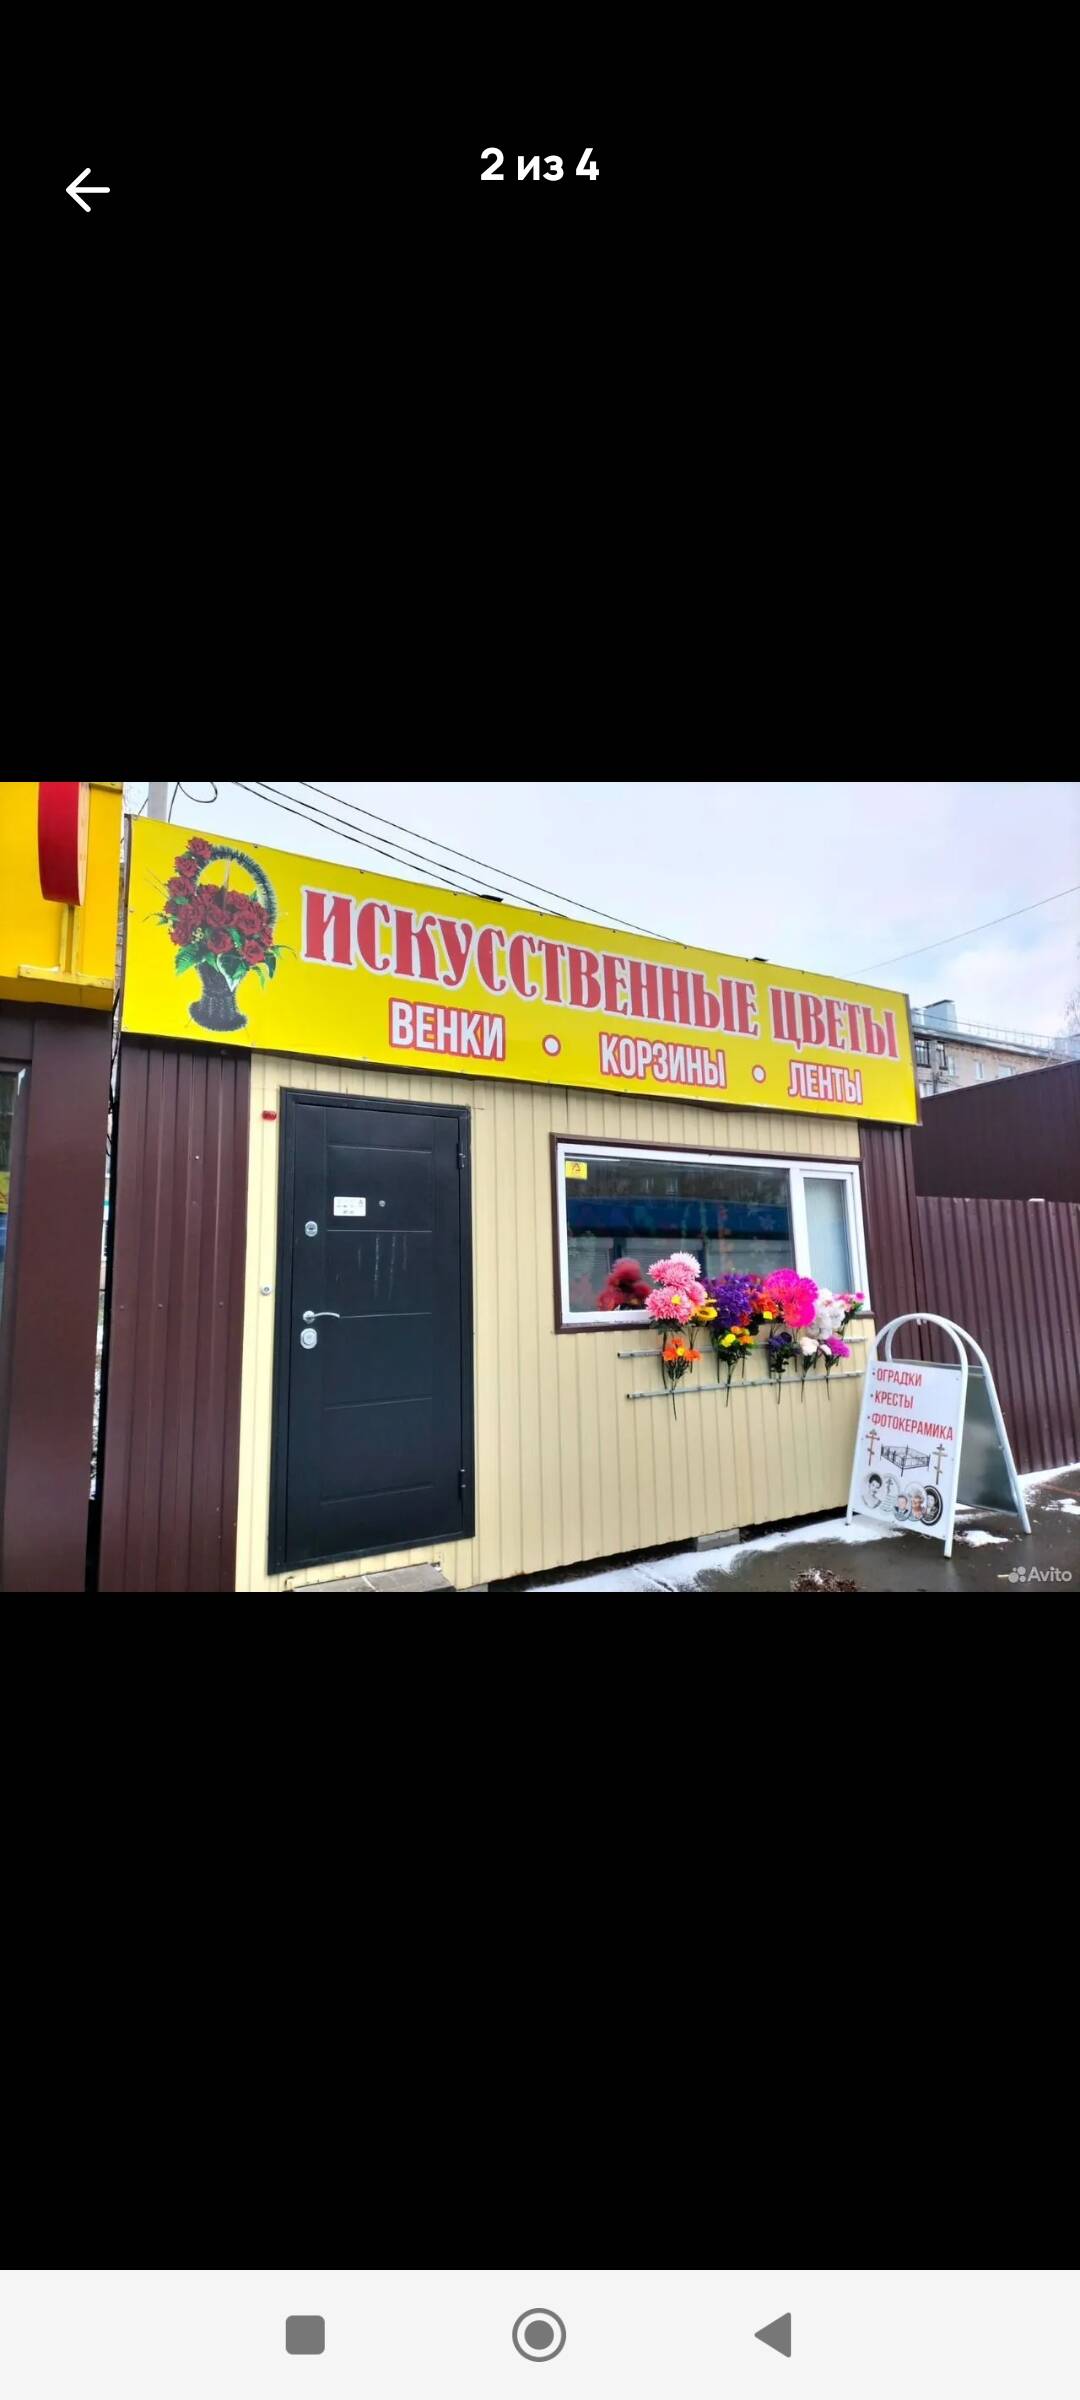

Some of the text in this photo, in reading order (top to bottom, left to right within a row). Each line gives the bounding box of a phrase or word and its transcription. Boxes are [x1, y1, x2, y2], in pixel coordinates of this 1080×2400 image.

[303, 888, 899, 1059] ИСКУССТВЕННЫЕ ЦВЕТЫ
[390, 998, 863, 1105] ВЕНКИ КОРЗИНЫ ЛЕНТЫ
[876, 1368, 923, 1387] ОГРАДКИ
[874, 1390, 914, 1409] КРЕСТЫ
[871, 1413, 953, 1441] ФОТОКЕРАМИКА
